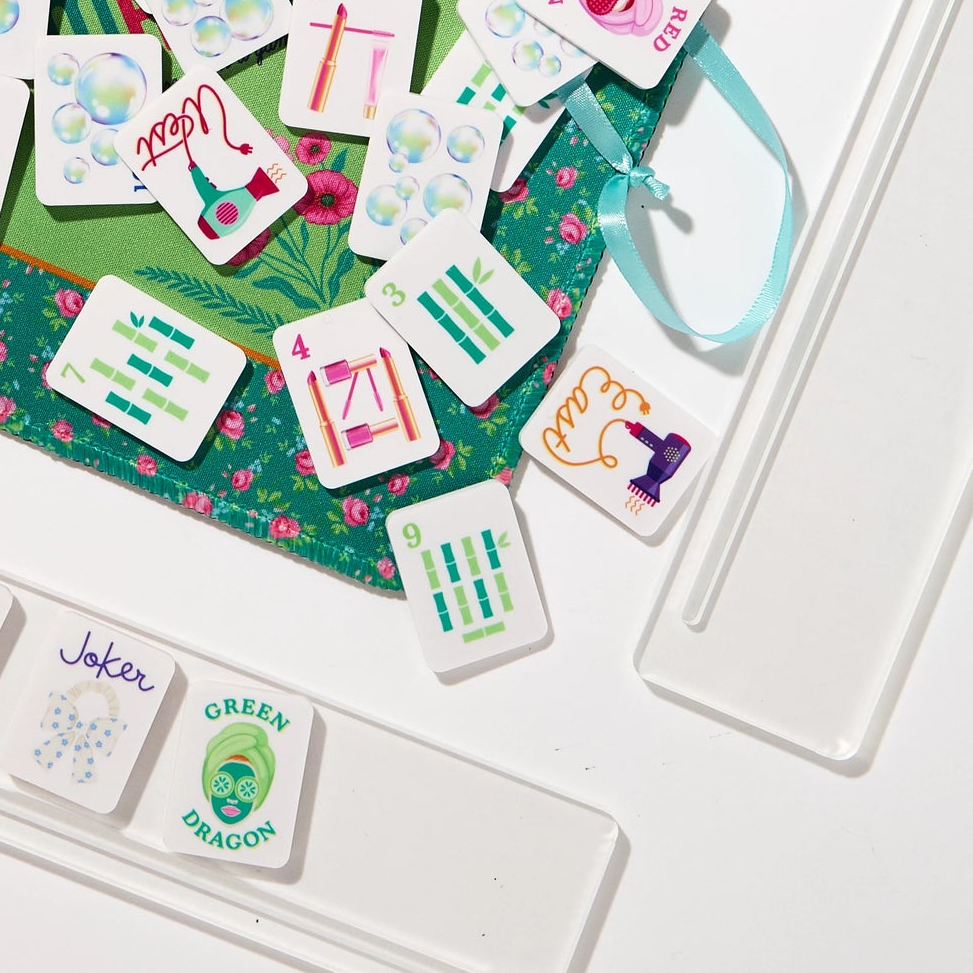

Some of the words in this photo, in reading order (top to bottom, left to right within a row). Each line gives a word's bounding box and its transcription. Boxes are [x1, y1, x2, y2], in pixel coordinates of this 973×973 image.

[653, 6, 688, 52] RED
[381, 281, 406, 307] 3
[291, 333, 311, 360] 4
[60, 362, 86, 384] 7
[402, 522, 422, 549] 9
[60, 630, 155, 692] Joker
[204, 698, 291, 733] GREEN
[181, 808, 277, 850] DRAGON
